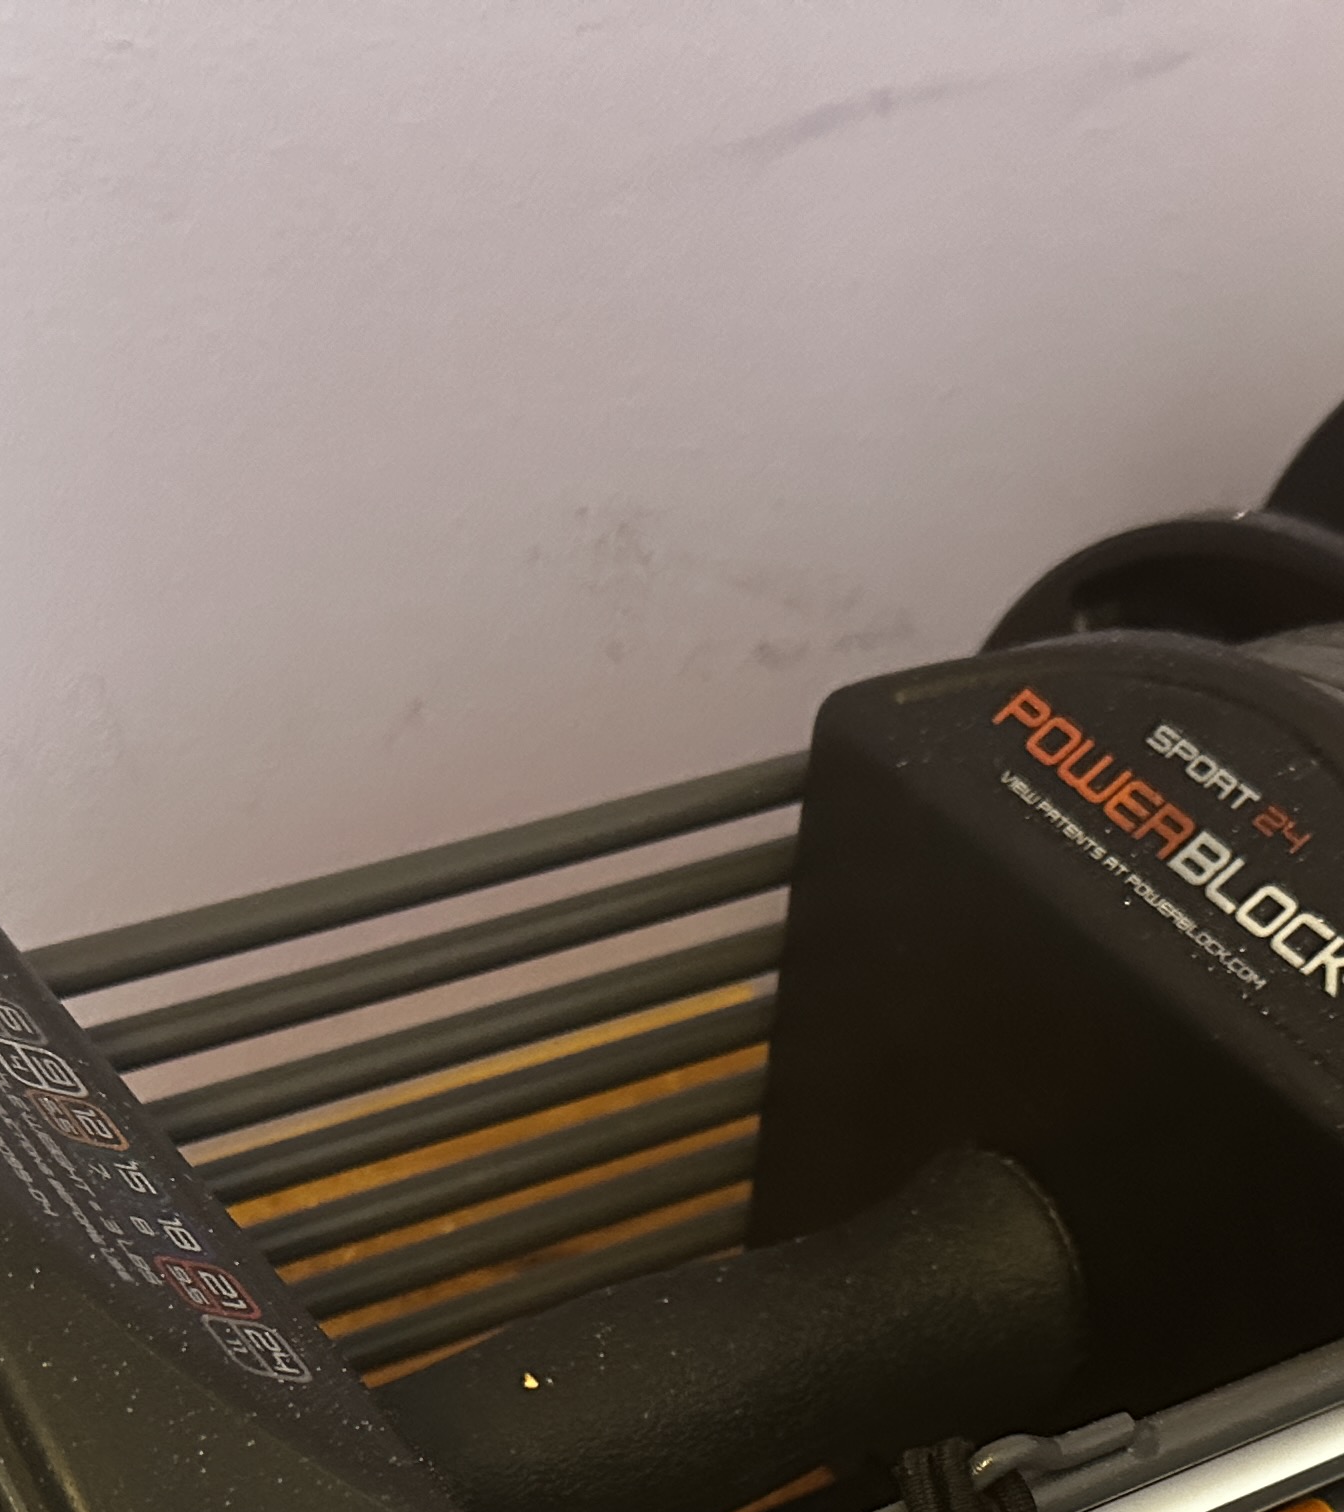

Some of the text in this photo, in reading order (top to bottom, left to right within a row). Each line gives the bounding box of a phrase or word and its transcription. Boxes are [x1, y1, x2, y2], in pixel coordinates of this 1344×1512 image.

[1000, 770, 1267, 990] VIEW PATENTS AT POWERBLOCK.COM
[1146, 724, 1314, 855] SPORT 24
[10, 1054, 31, 1072] 4
[87, 1163, 111, 1180] 7
[129, 1216, 155, 1236] 8
[226, 1338, 249, 1354] 11
[21, 1111, 96, 1197] WEIGHT
[101, 1217, 124, 1235] 3
[116, 1239, 163, 1286] LBS
[30, 1055, 77, 1087] 9
[71, 1109, 114, 1140] 12
[113, 1161, 157, 1194] 15
[157, 1216, 202, 1251] 18
[197, 1270, 248, 1309] 21
[243, 1328, 301, 1375] 24
